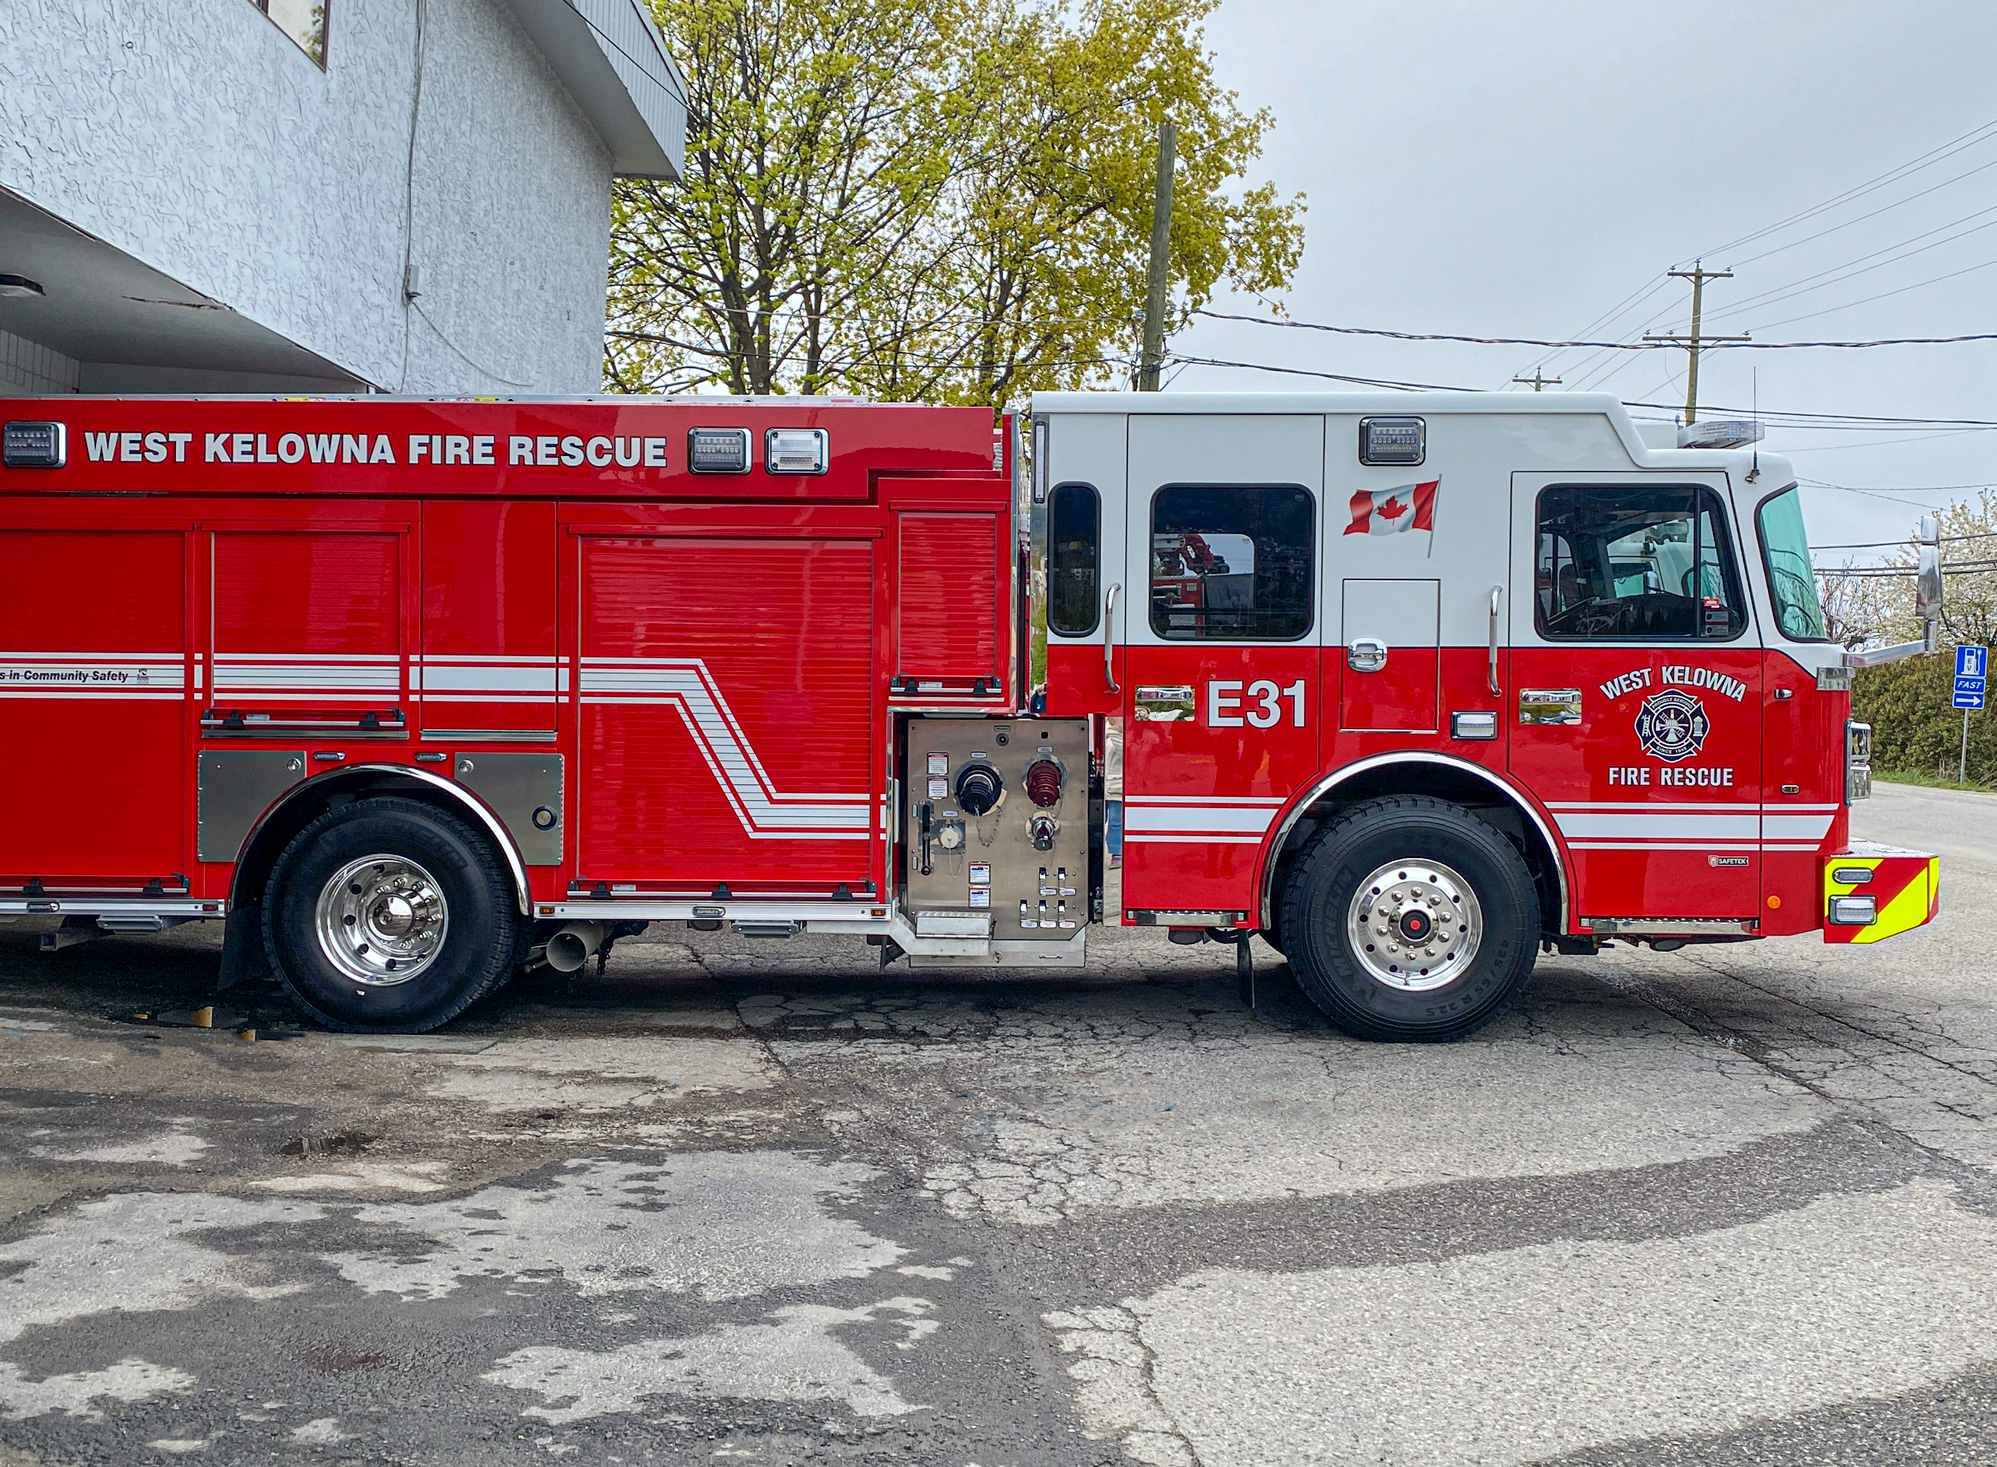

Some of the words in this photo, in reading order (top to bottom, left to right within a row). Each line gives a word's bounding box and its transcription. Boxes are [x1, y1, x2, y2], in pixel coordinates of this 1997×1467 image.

[84, 431, 192, 462] WEST
[204, 432, 396, 464] KELOWNA
[408, 434, 496, 466] FIRE
[508, 435, 668, 468] RESCUE
[9, 670, 20, 680] in
[24, 670, 89, 683] Community
[92, 671, 129, 683] Safety
[1599, 667, 1653, 700] WEST
[1661, 665, 1747, 703] KELOWNA
[1957, 680, 1983, 689] FAST
[1208, 679, 1306, 729] E31
[1608, 767, 1650, 786] FIRE
[1660, 767, 1734, 787] RESCUE
[1325, 867, 1355, 978] MICHELIN
